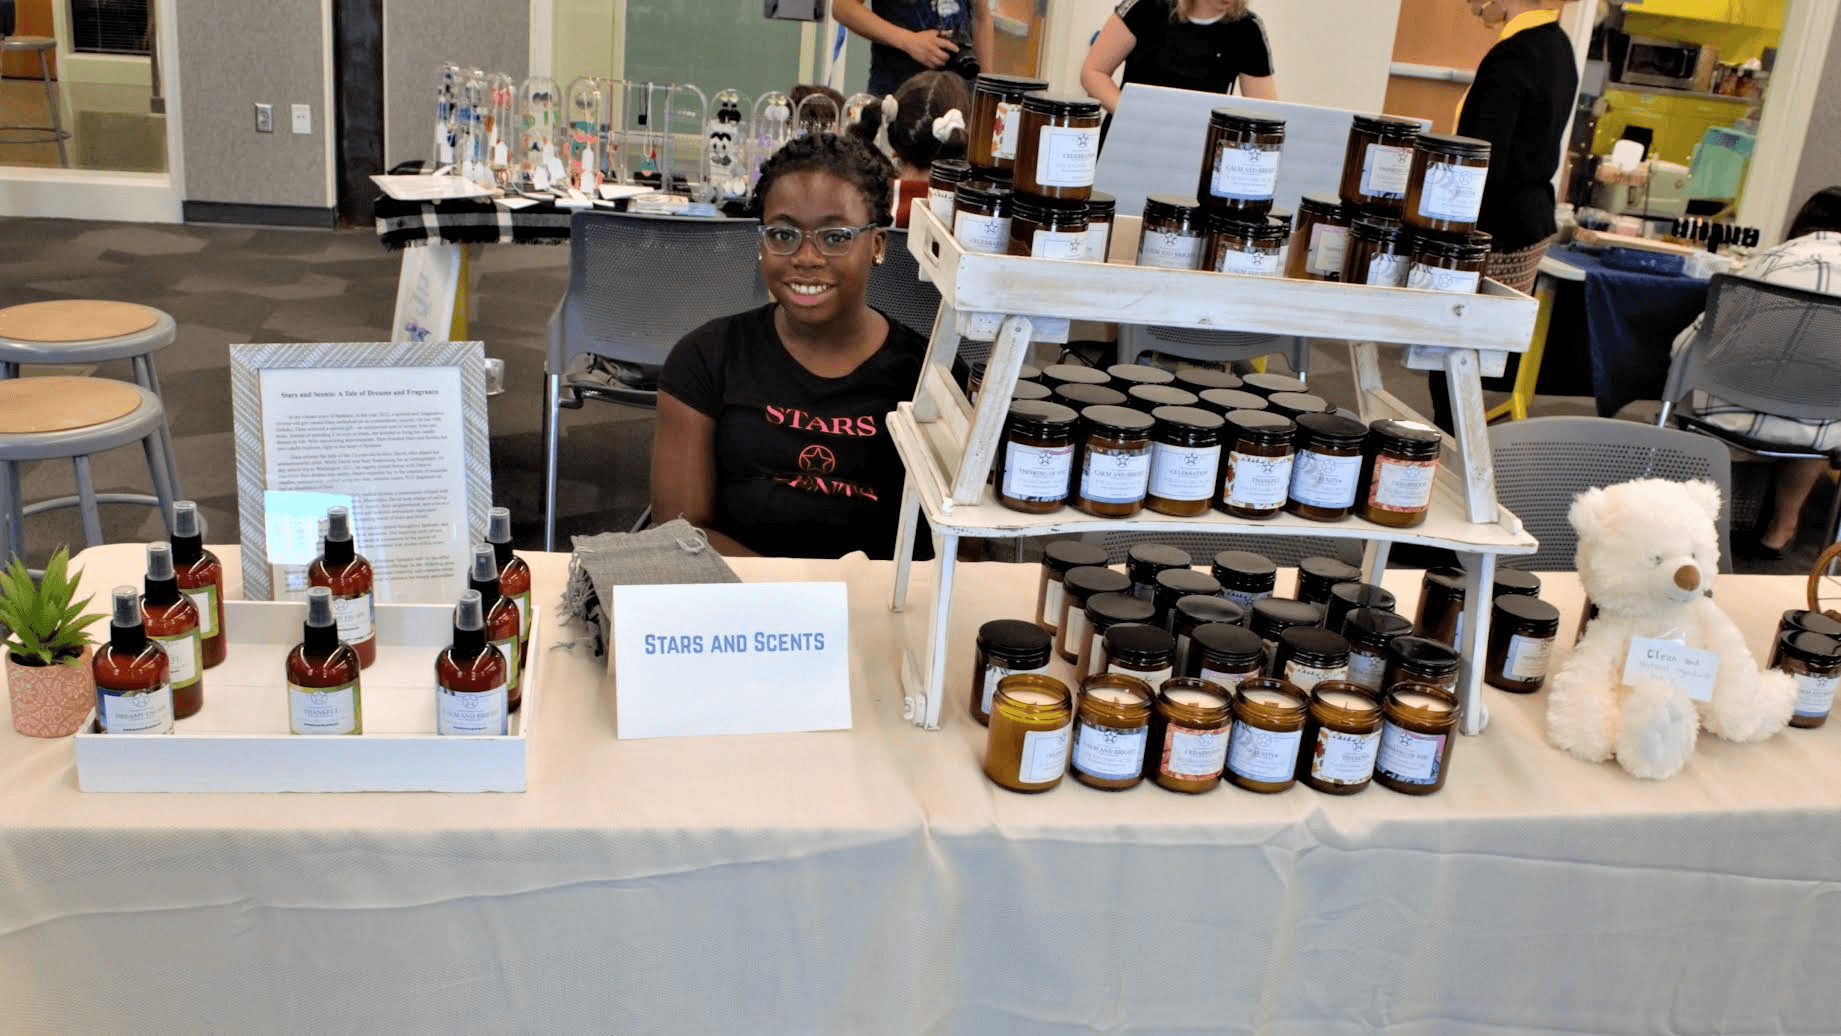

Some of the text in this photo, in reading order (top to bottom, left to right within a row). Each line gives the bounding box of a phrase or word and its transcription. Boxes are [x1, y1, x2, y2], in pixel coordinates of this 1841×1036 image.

[359, 389, 366, 397] of
[406, 388, 439, 397] Fragrance
[766, 405, 877, 437] STARS
[645, 631, 825, 655] STARS AND SCENTS
[1647, 649, 1677, 661] Clean
